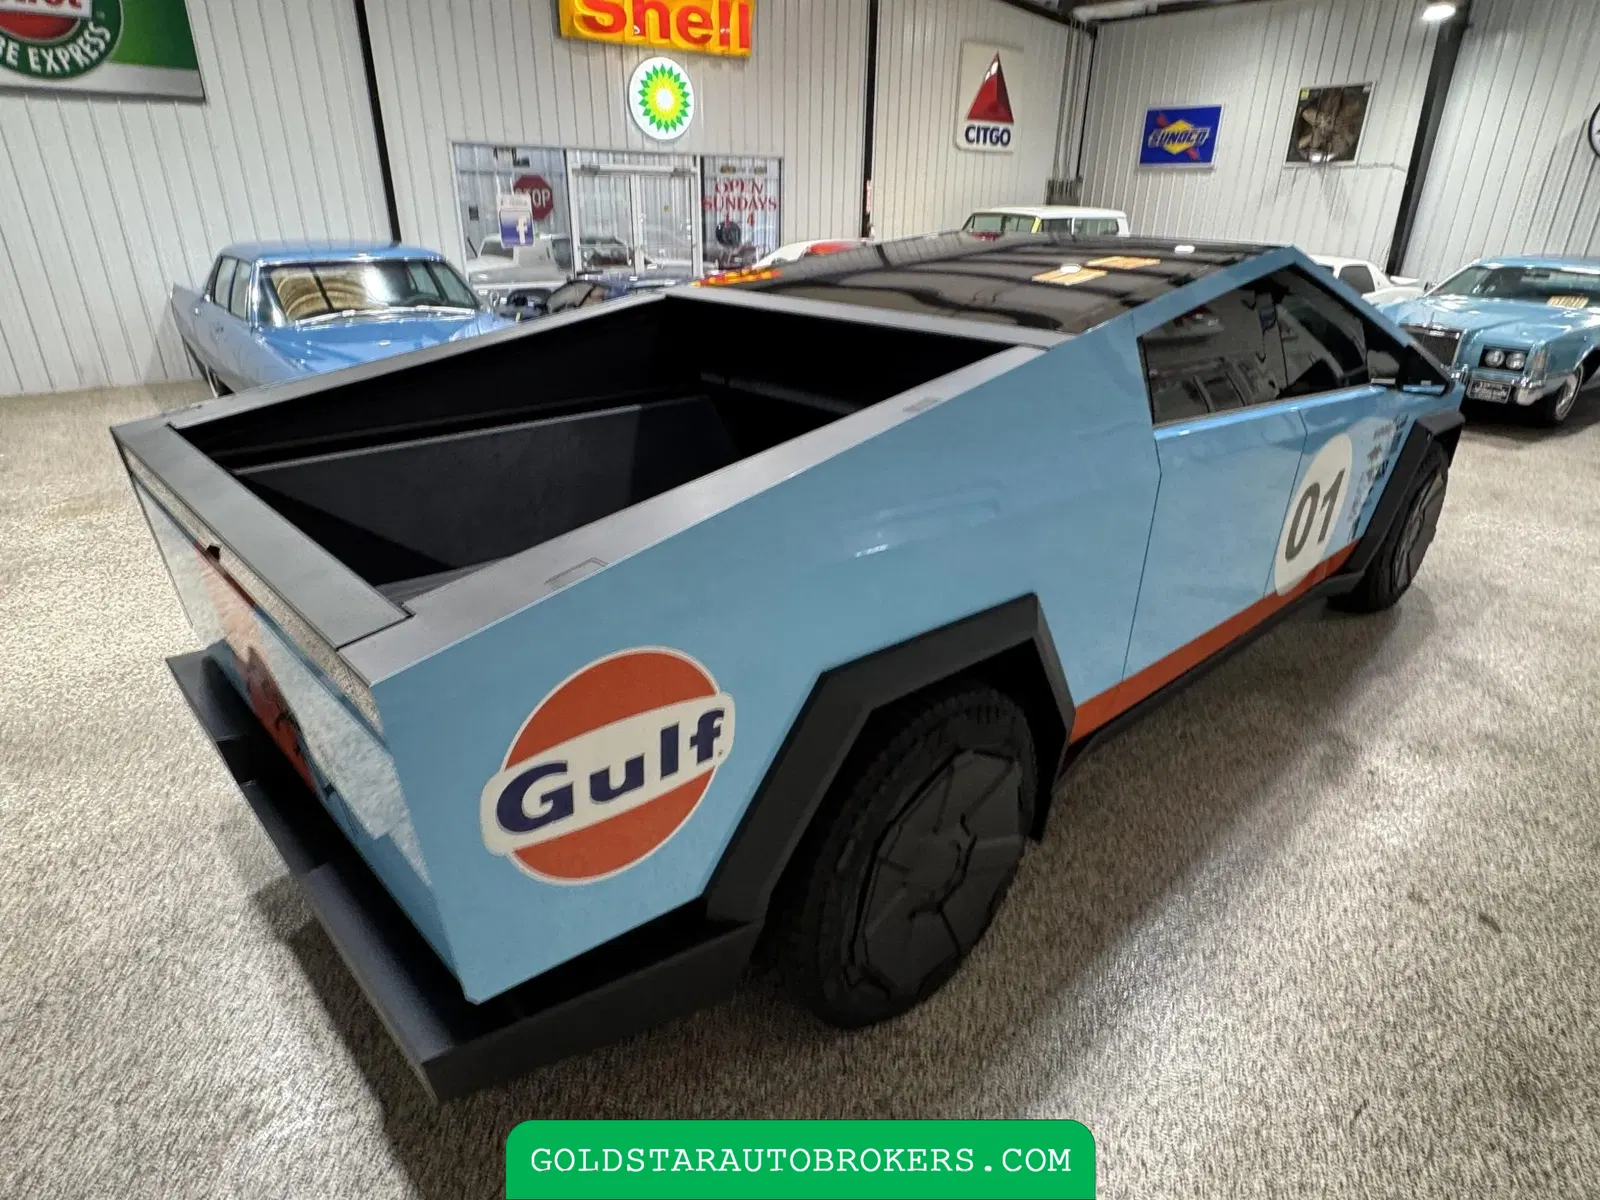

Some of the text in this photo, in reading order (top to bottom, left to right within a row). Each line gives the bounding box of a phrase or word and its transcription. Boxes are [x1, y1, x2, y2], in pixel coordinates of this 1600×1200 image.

[28, 21, 111, 74] EXPRESS
[582, 0, 751, 49] Shell
[964, 124, 1011, 147] CITGO
[701, 195, 777, 213] SUNDAYS
[1285, 467, 1346, 562] 01
[496, 707, 725, 835] Gulf
